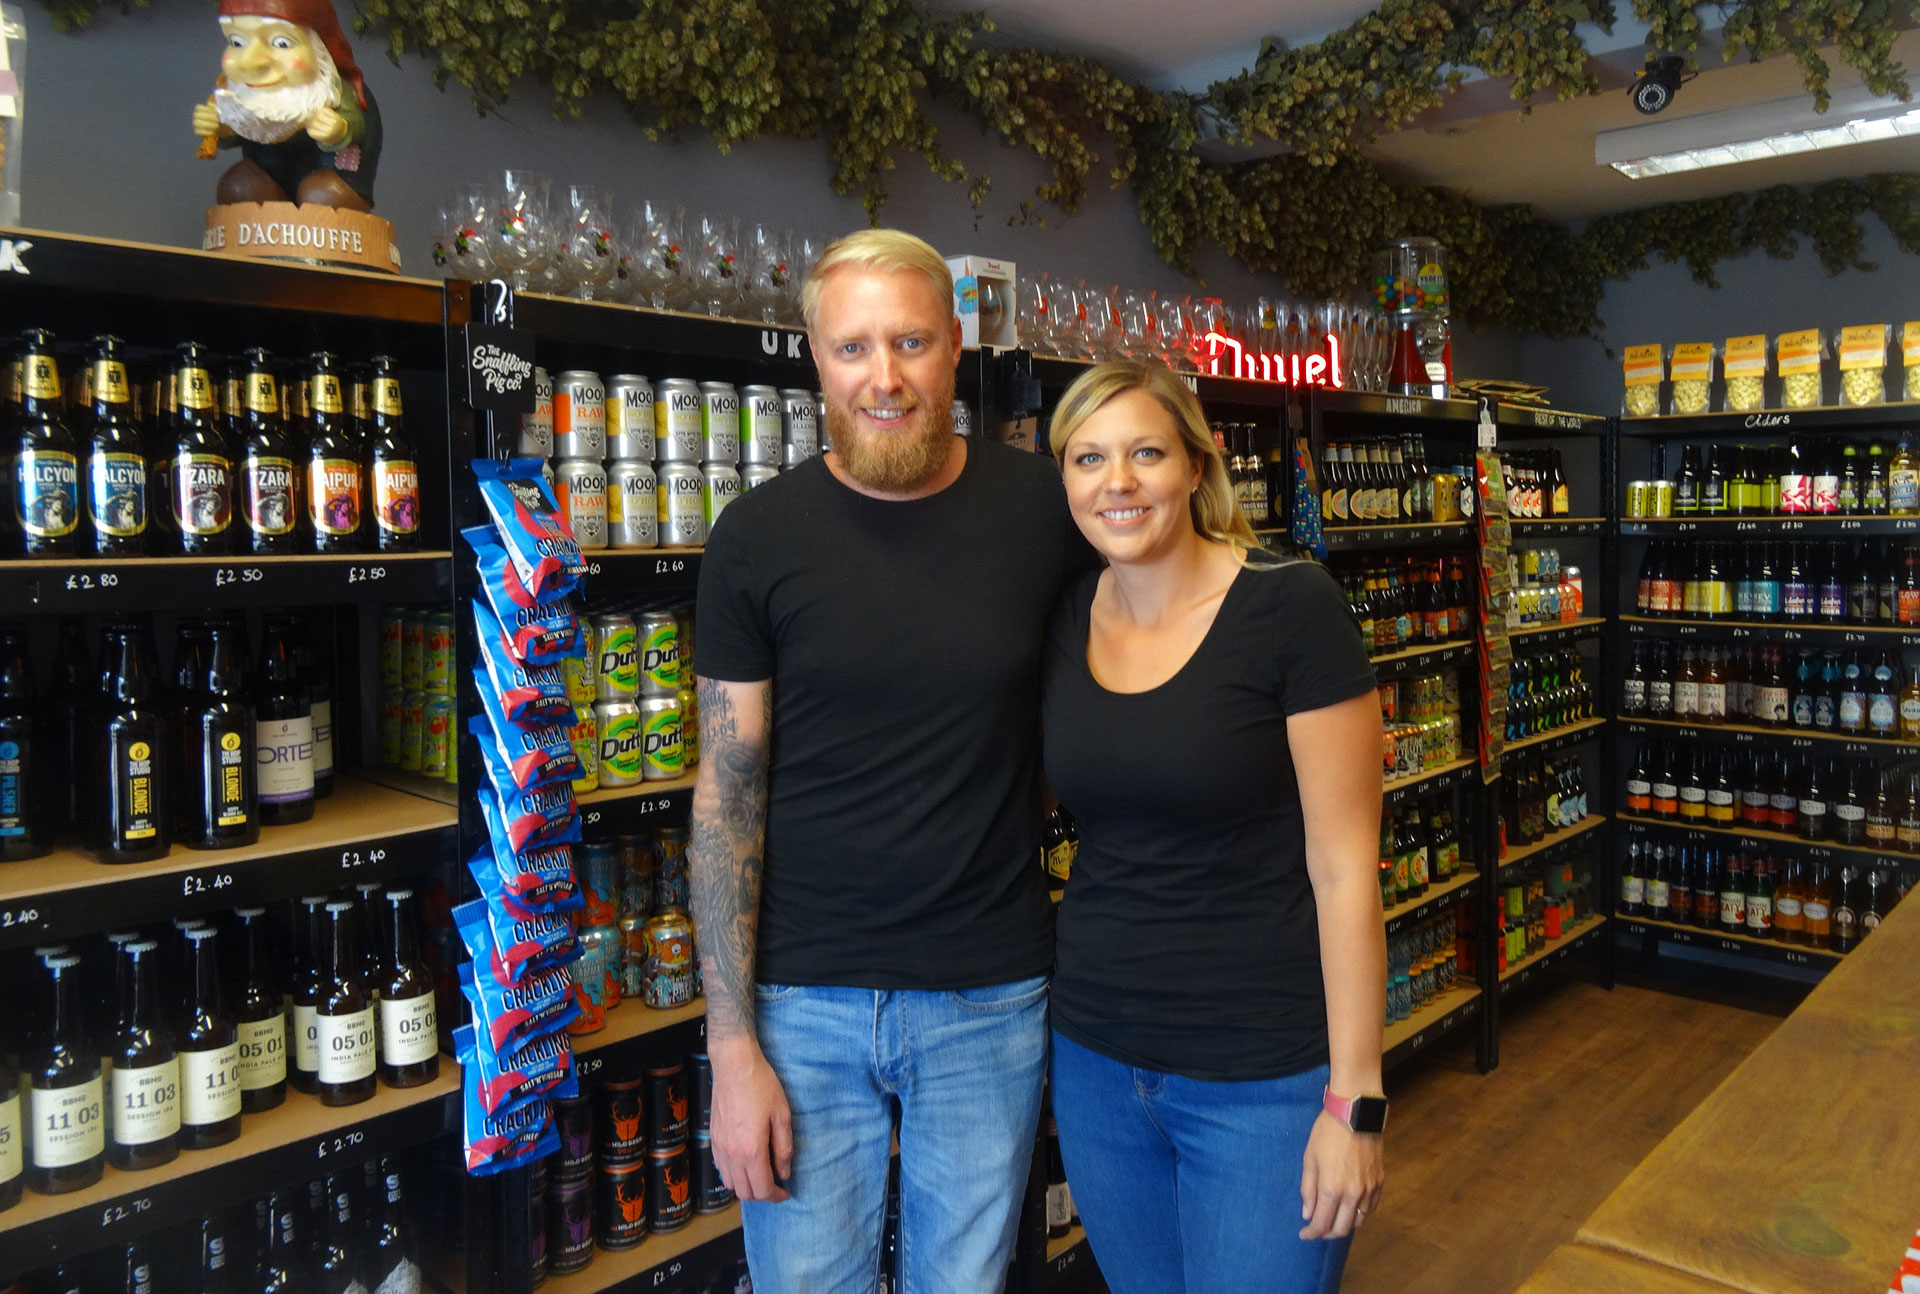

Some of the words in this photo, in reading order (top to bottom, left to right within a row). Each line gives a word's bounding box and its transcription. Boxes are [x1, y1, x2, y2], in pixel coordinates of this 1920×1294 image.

[238, 222, 363, 254] D'ACHOUFFE
[487, 344, 500, 356] THE
[472, 345, 532, 379] Snaffling
[482, 368, 506, 394] Pig
[573, 386, 605, 405] MOO
[625, 389, 652, 408] MOO
[671, 393, 701, 412] MOO
[711, 396, 739, 414] MOO
[756, 399, 781, 417] MOO
[792, 404, 817, 421] MOO
[1385, 399, 1422, 414] AMERICA
[1744, 414, 1790, 429] Ciders
[18, 466, 77, 484] HLCYON
[714, 479, 740, 496] MOO
[573, 496, 604, 508] RAW
[257, 740, 313, 764] ORTE
[129, 766, 151, 776] STUDIO
[225, 766, 239, 803] BLONDE
[133, 777, 148, 816] BLONDE
[641, 799, 671, 814] £2.50
[342, 849, 386, 868] £2.40
[515, 848, 573, 874] CRACKLIN
[184, 874, 233, 896] £2.40
[501, 966, 572, 1012] CRACKLIN
[239, 1042, 263, 1059] 05
[332, 1034, 356, 1051] 05
[205, 1070, 228, 1090] 11
[125, 1092, 149, 1110] 11
[154, 1083, 176, 1105] 03
[47, 1111, 72, 1132] 11
[78, 1102, 100, 1125] 03
[126, 1109, 162, 1121] SESSION
[49, 1131, 86, 1143] SESSION
